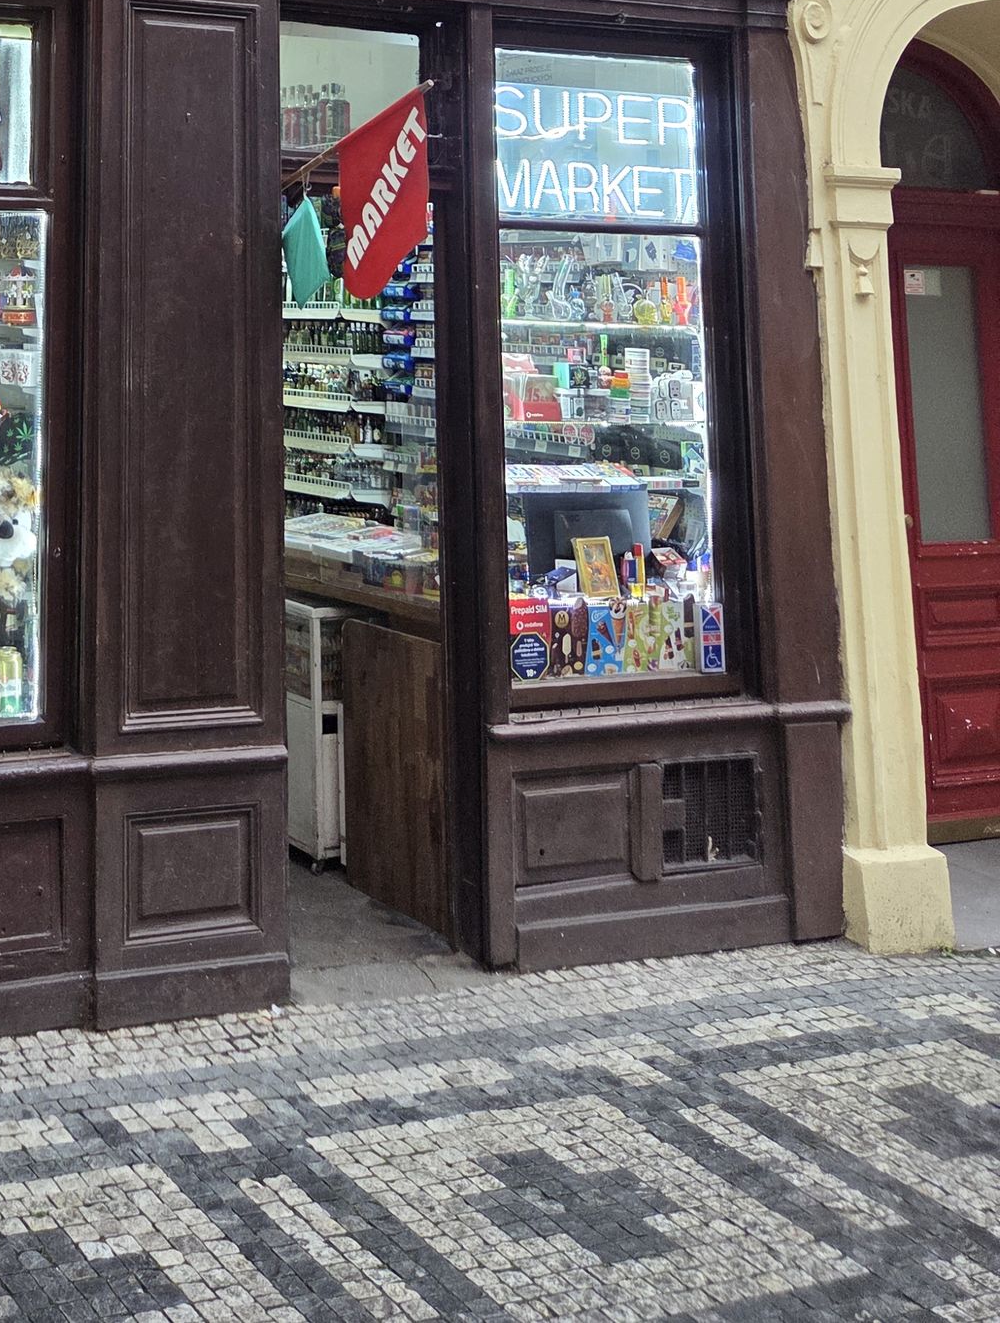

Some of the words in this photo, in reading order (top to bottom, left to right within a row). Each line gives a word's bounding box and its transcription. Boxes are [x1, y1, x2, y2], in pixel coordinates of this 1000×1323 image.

[495, 85, 694, 146] SUPER
[346, 106, 428, 271] MARKET
[495, 157, 696, 224] MARKET
[510, 605, 535, 616] Prepaid
[535, 604, 548, 614] SIM
